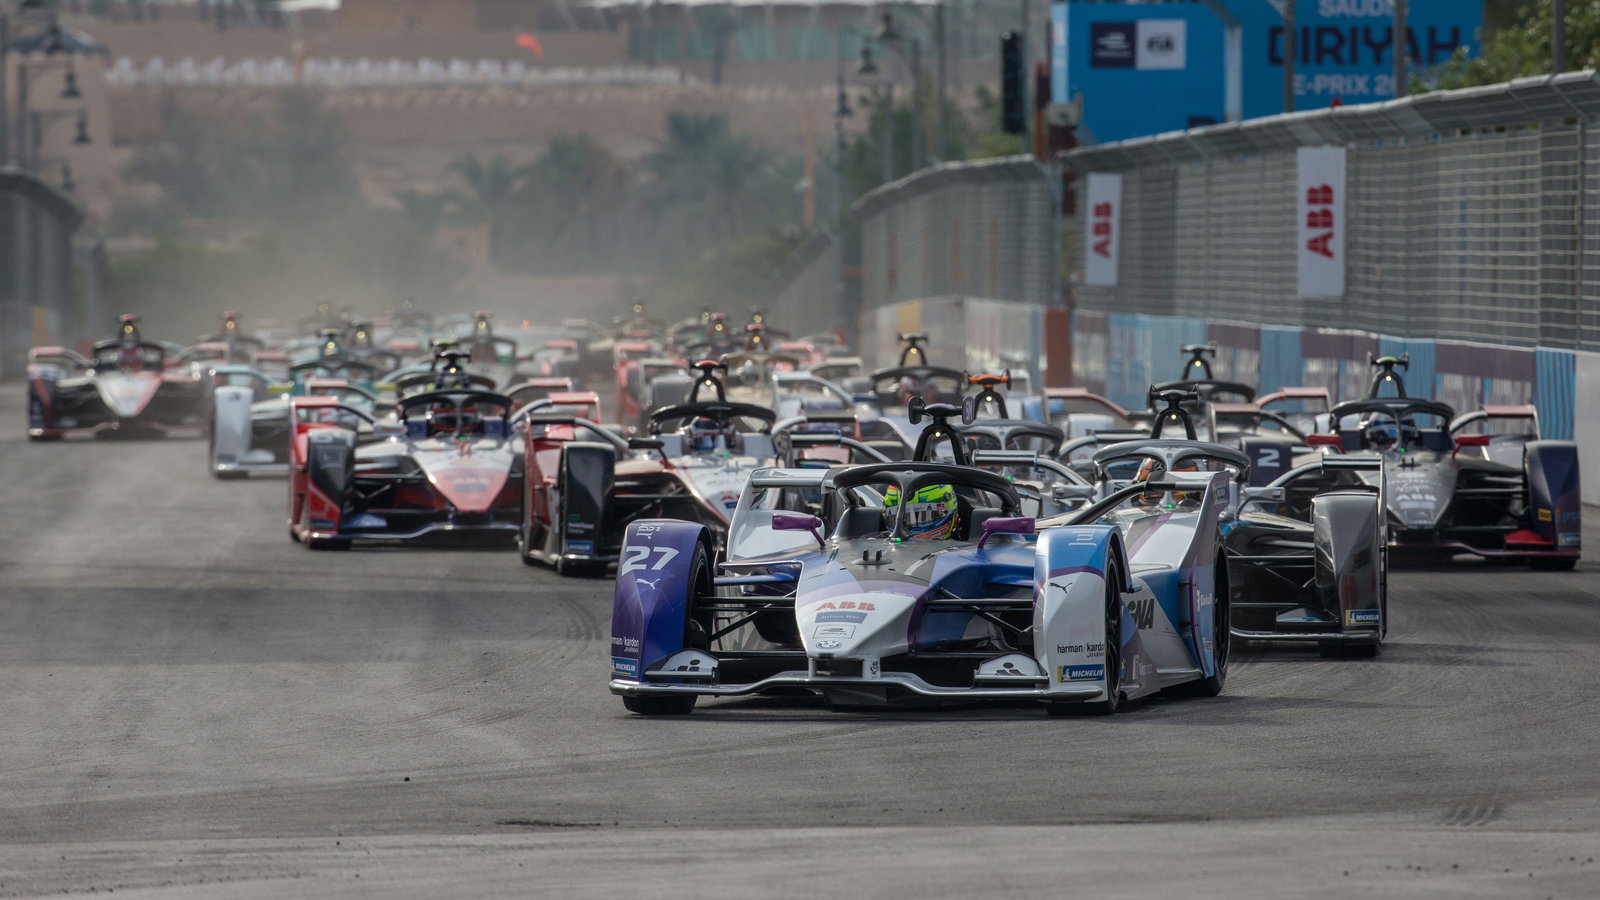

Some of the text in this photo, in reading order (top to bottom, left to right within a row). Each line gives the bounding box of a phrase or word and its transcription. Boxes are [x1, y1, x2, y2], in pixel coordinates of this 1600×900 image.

[1269, 27, 1460, 65] DIRIYAH
[1293, 74, 1369, 95] E-PRIX
[1092, 201, 1113, 259] ABB
[1307, 183, 1334, 259] ABB
[1257, 448, 1281, 467] 2
[622, 545, 679, 576] 27
[815, 601, 876, 611] ABB
[1071, 669, 1103, 677] MICHELIN
